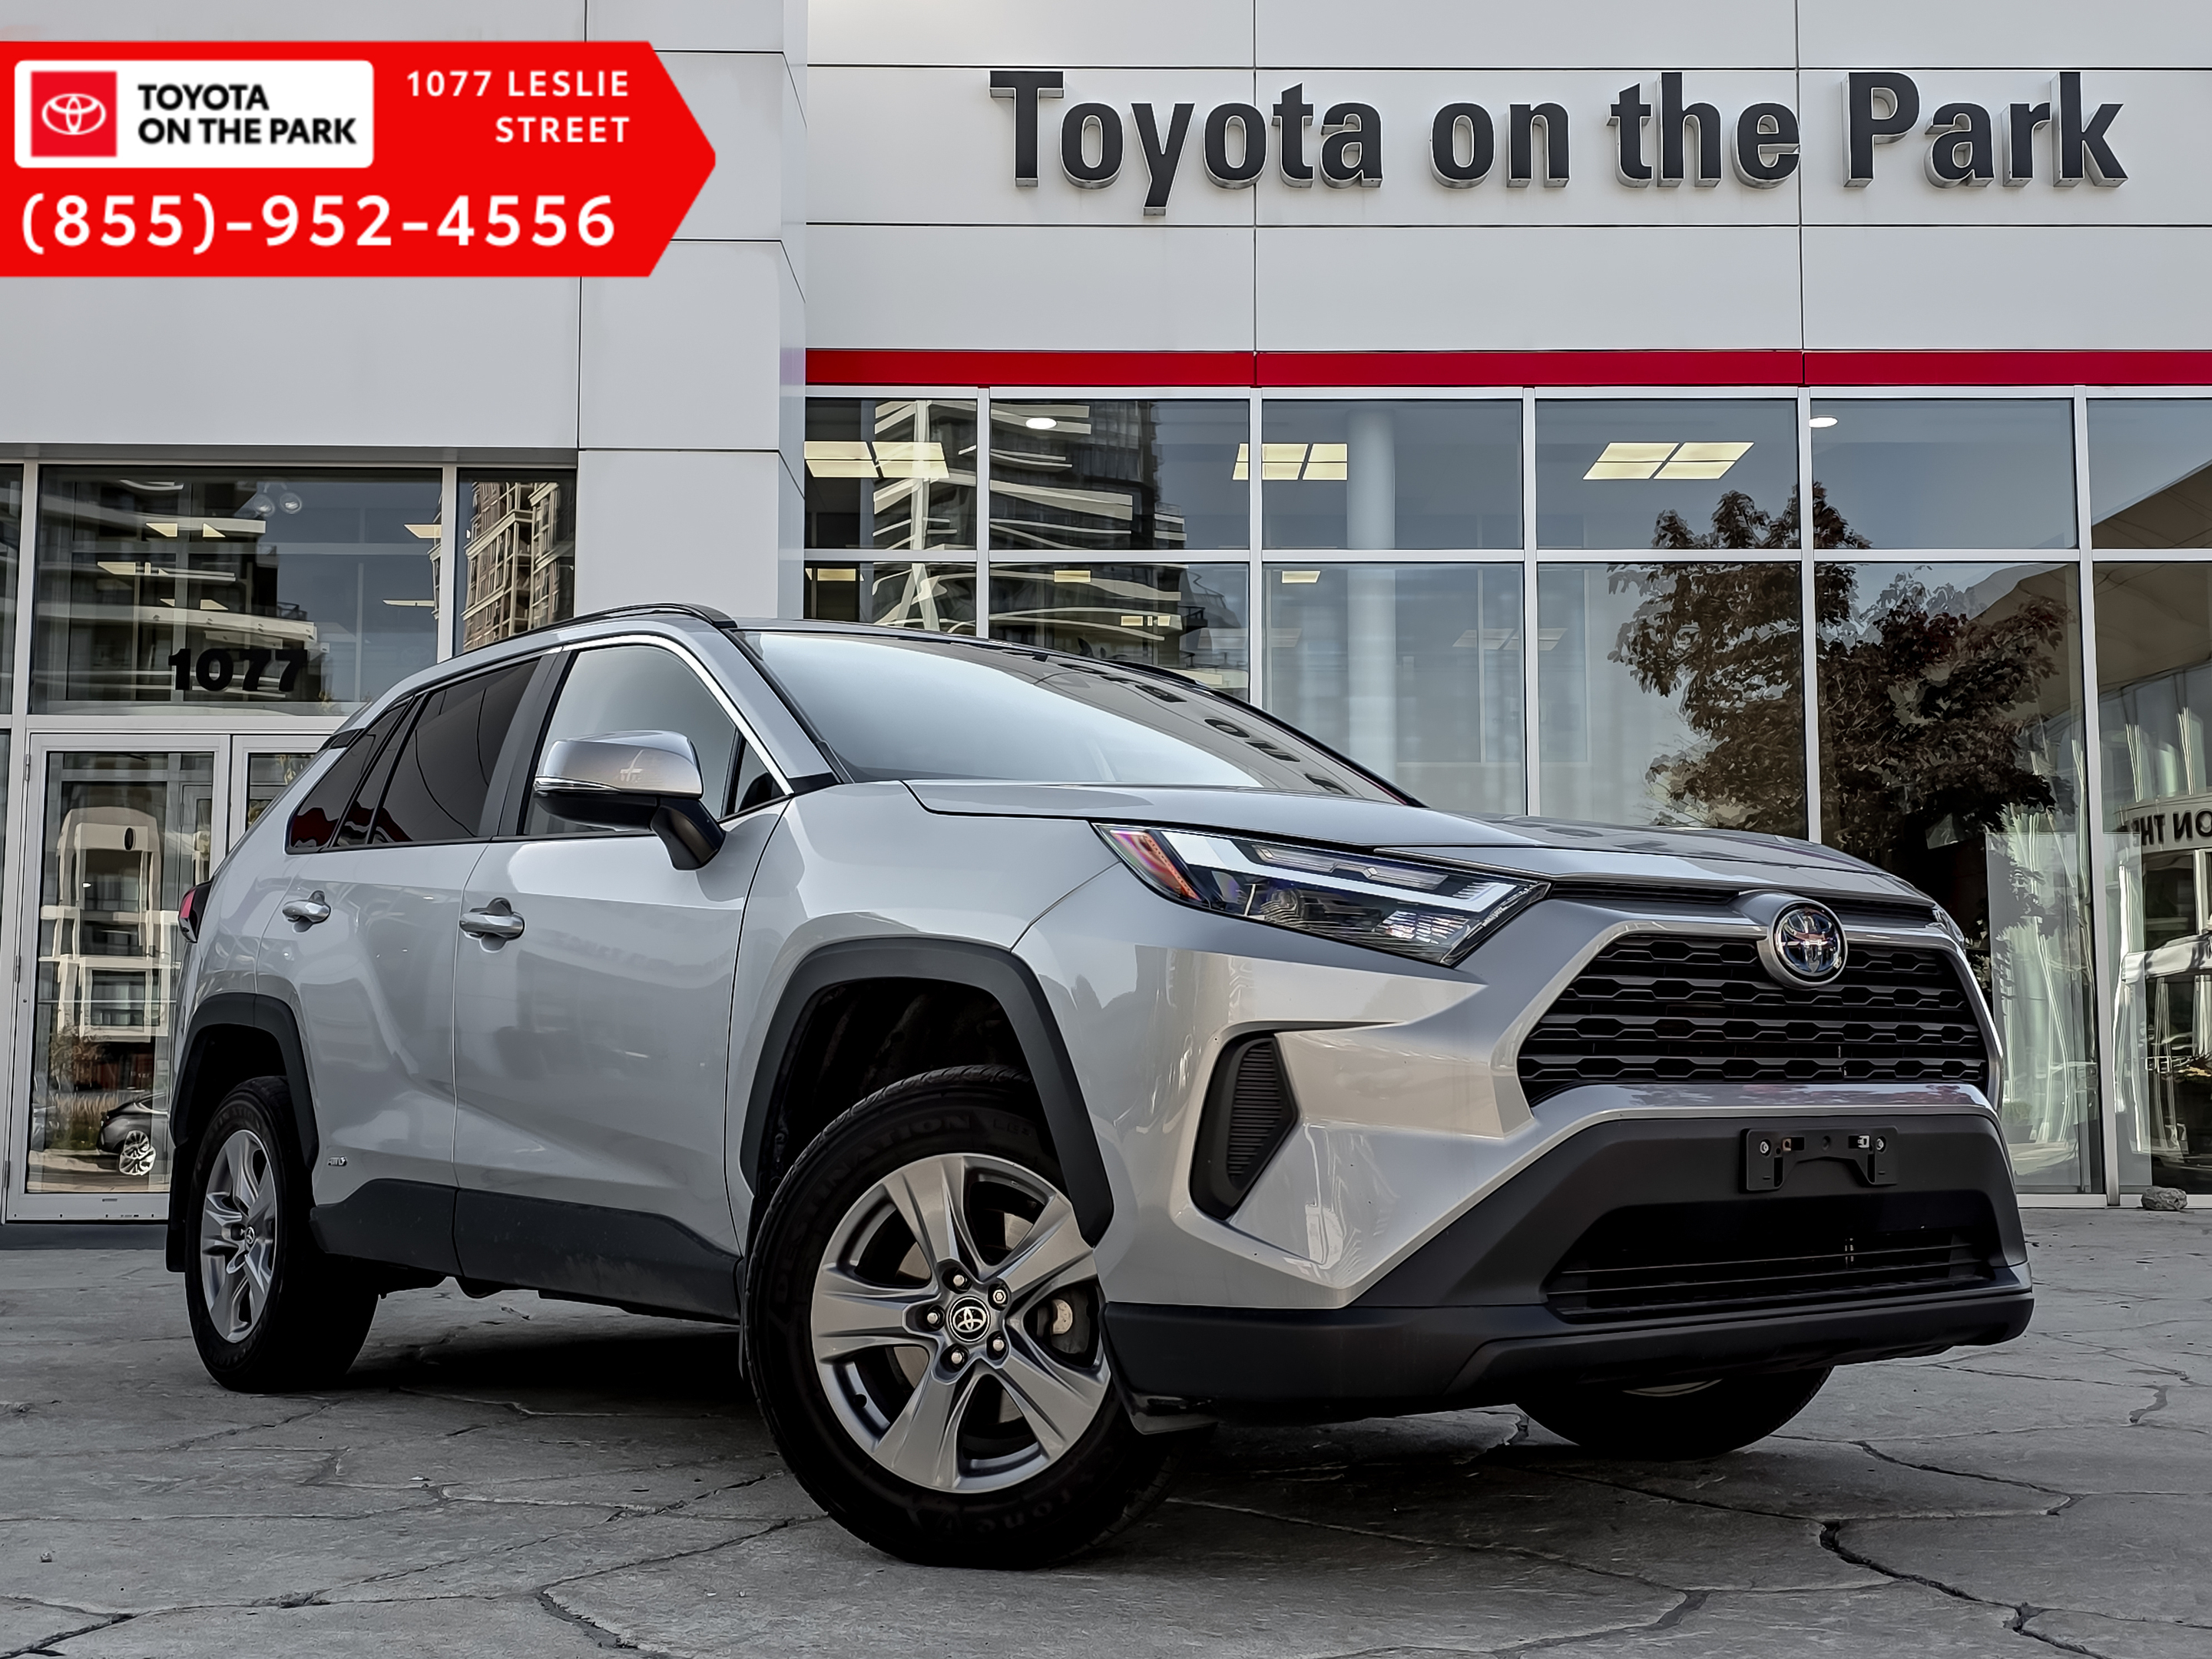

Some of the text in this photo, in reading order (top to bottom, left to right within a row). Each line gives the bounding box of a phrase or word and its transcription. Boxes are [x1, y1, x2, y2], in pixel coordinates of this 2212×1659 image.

[989, 70, 2129, 216] Toyota on the Park
[168, 647, 308, 691] 1077
